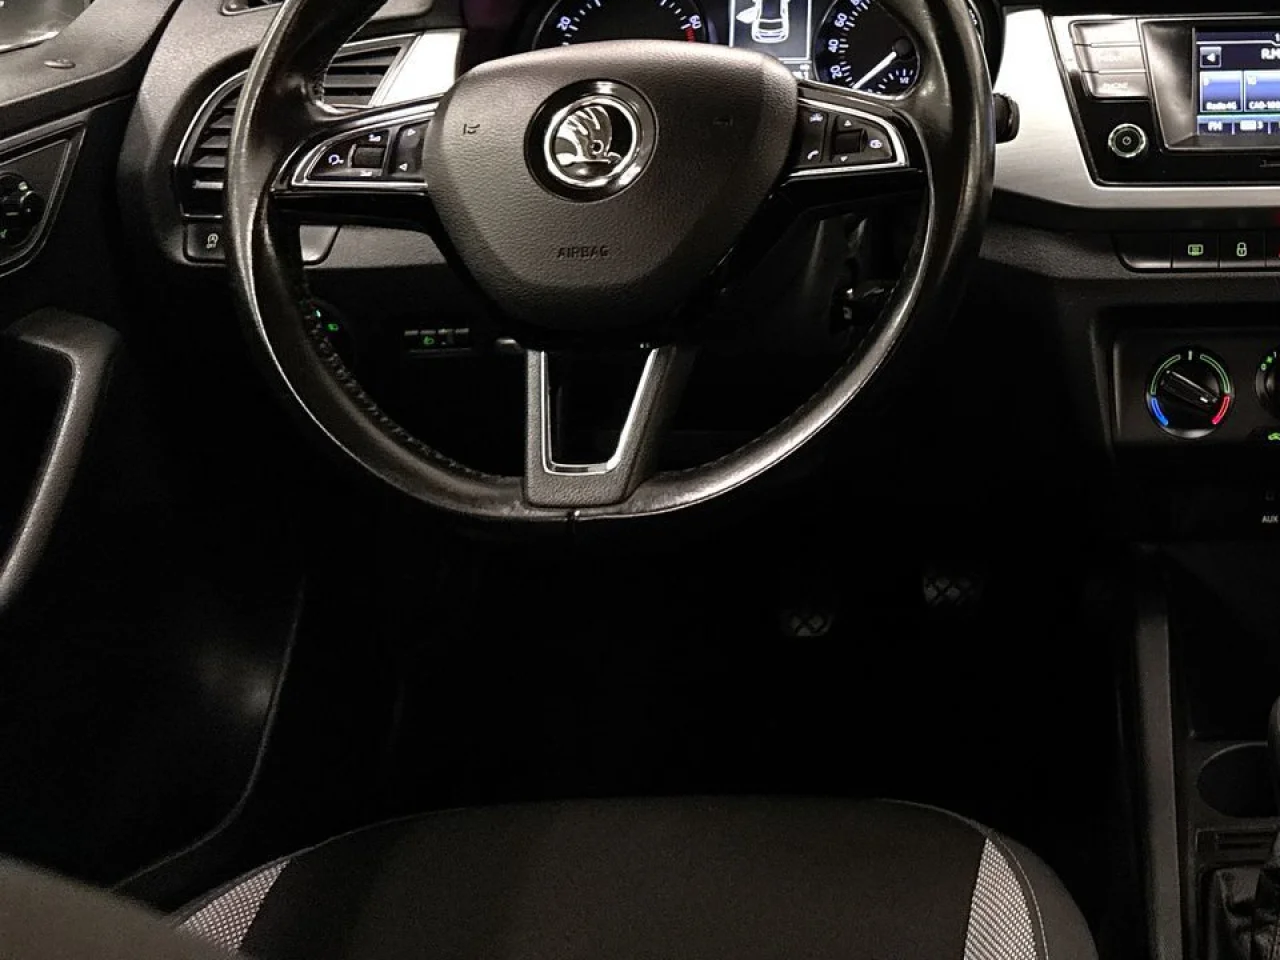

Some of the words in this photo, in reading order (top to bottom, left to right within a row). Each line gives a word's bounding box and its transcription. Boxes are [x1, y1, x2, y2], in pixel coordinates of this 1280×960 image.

[556, 15, 571, 31] 20
[688, 14, 702, 30] 60
[834, 12, 848, 28] 60
[828, 39, 840, 53] 40
[830, 65, 842, 80] 20
[556, 246, 610, 259] AIRBAG
[1261, 515, 1279, 523] AUX
